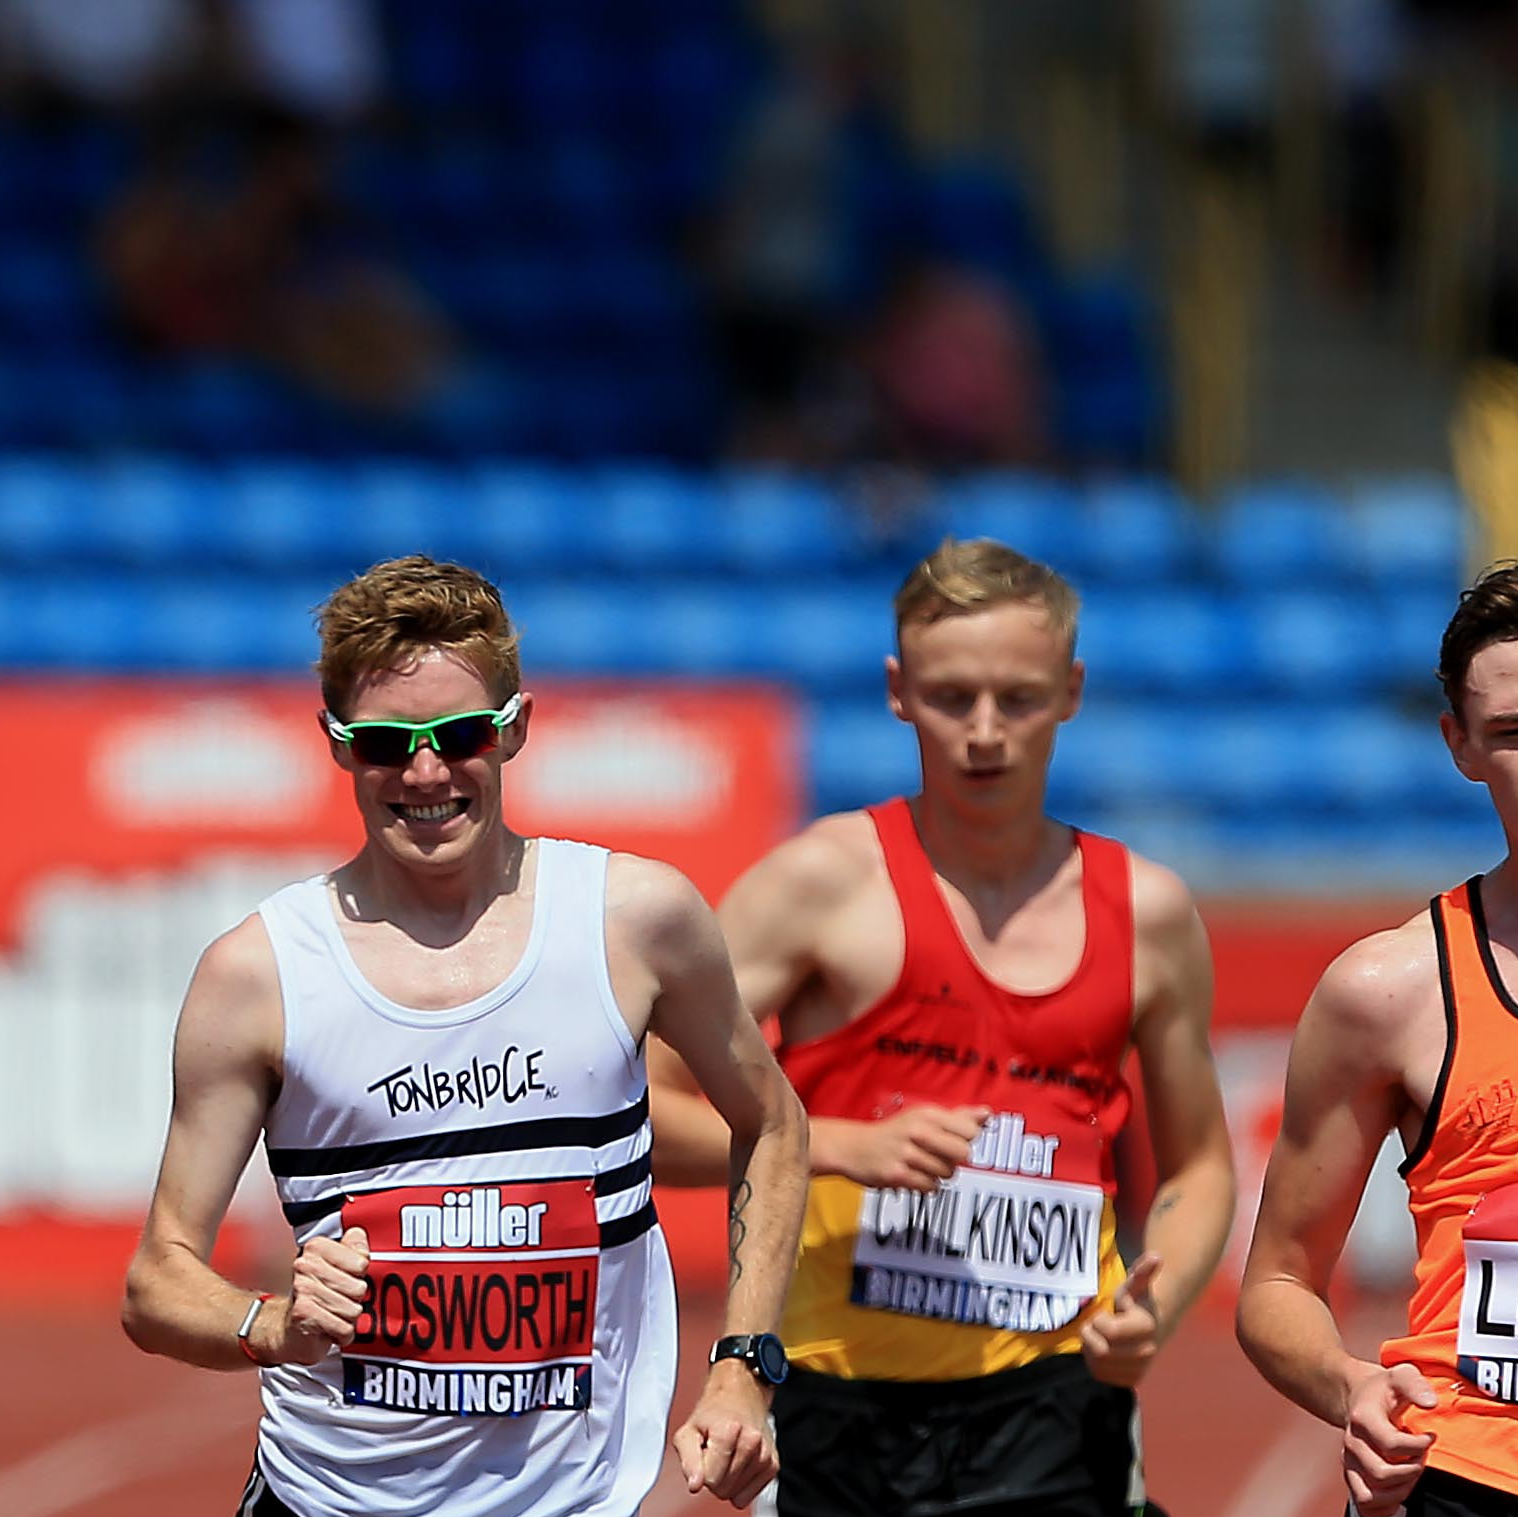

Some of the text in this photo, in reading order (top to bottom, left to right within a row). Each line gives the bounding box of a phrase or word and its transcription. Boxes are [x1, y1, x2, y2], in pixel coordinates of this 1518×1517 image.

[367, 1045, 546, 1118] TONBRIDGE
[968, 1110, 1059, 1178] üller
[400, 1188, 547, 1249] müller
[354, 1269, 589, 1352] BOSWORTH
[867, 1266, 1081, 1332] BIRMINGHAM
[362, 1363, 576, 1414] BIRMINGHAM
